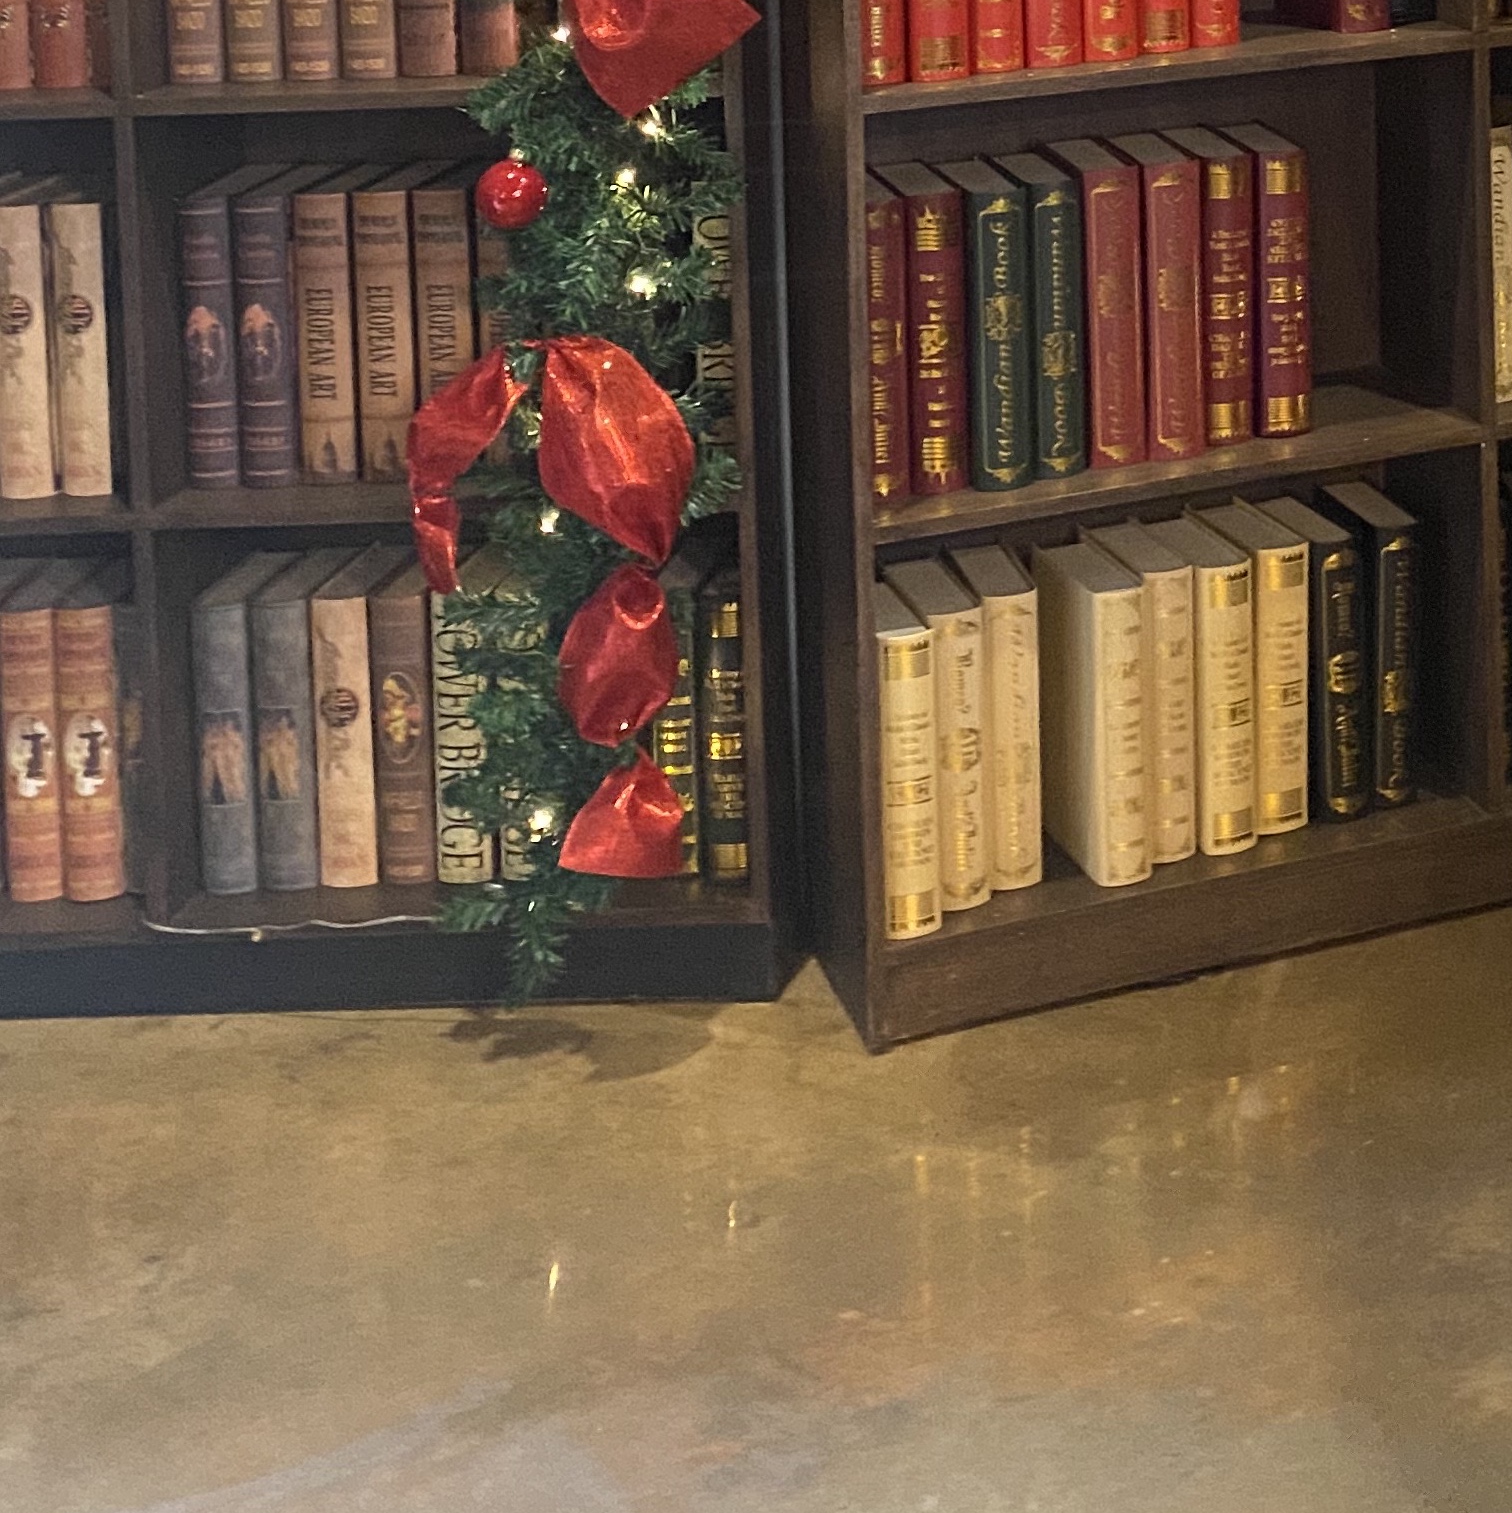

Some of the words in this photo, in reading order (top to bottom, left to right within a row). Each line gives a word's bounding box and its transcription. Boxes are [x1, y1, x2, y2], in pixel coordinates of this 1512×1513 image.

[990, 221, 1010, 289] Book
[305, 288, 336, 366] EUROPEAN
[366, 285, 397, 364] EUROPEAN
[426, 284, 456, 362] EUROPEAN
[309, 373, 338, 400] ART
[370, 371, 398, 397] ART
[993, 342, 1012, 463] Wandian
[439, 746, 488, 870] BRGE
